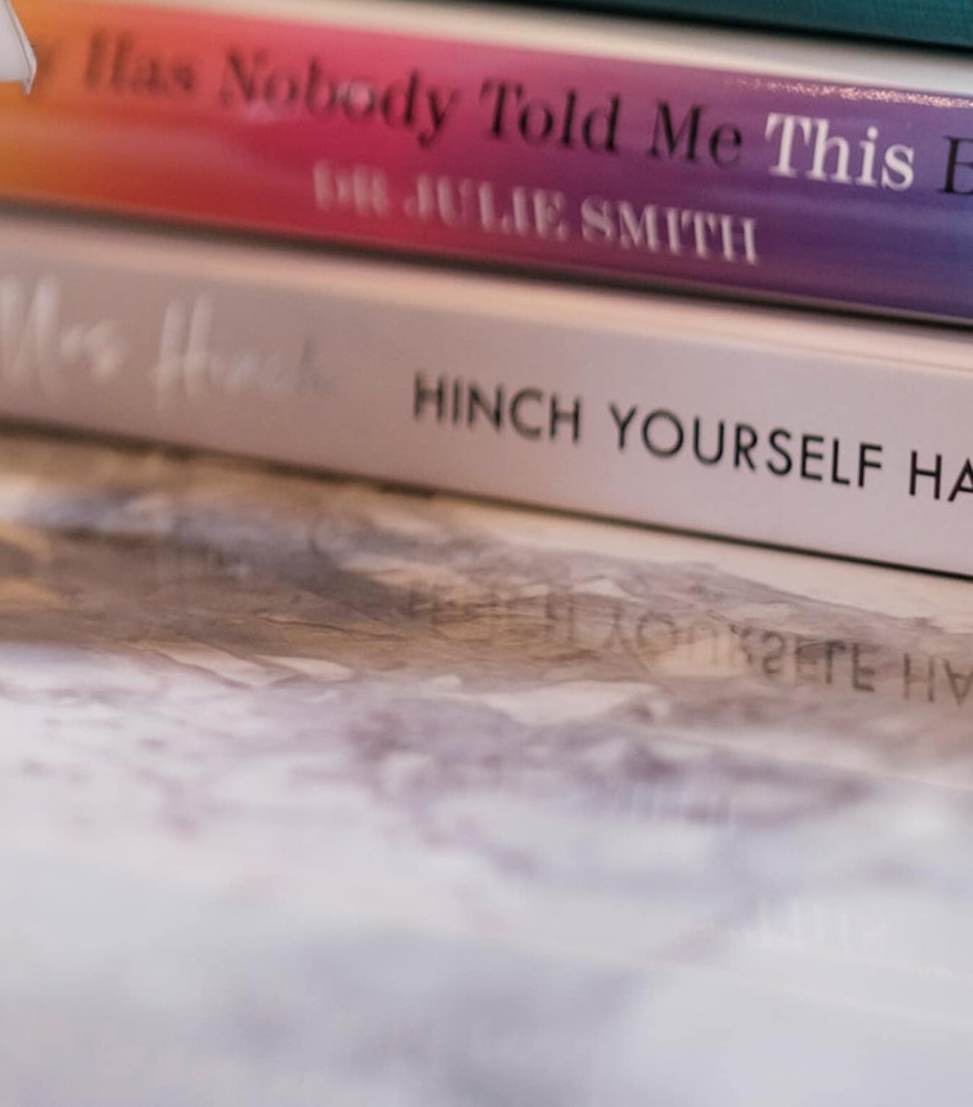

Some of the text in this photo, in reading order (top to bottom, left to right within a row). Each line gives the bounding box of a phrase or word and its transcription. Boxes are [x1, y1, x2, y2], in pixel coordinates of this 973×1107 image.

[83, 27, 197, 92] Has
[220, 40, 461, 149] Nobody
[479, 78, 621, 154] Told
[644, 99, 744, 167] Me
[764, 111, 914, 192] This
[314, 158, 759, 265] DR JULIE SMITH
[413, 372, 582, 444] HINCH
[608, 401, 883, 488] YOURSELF
